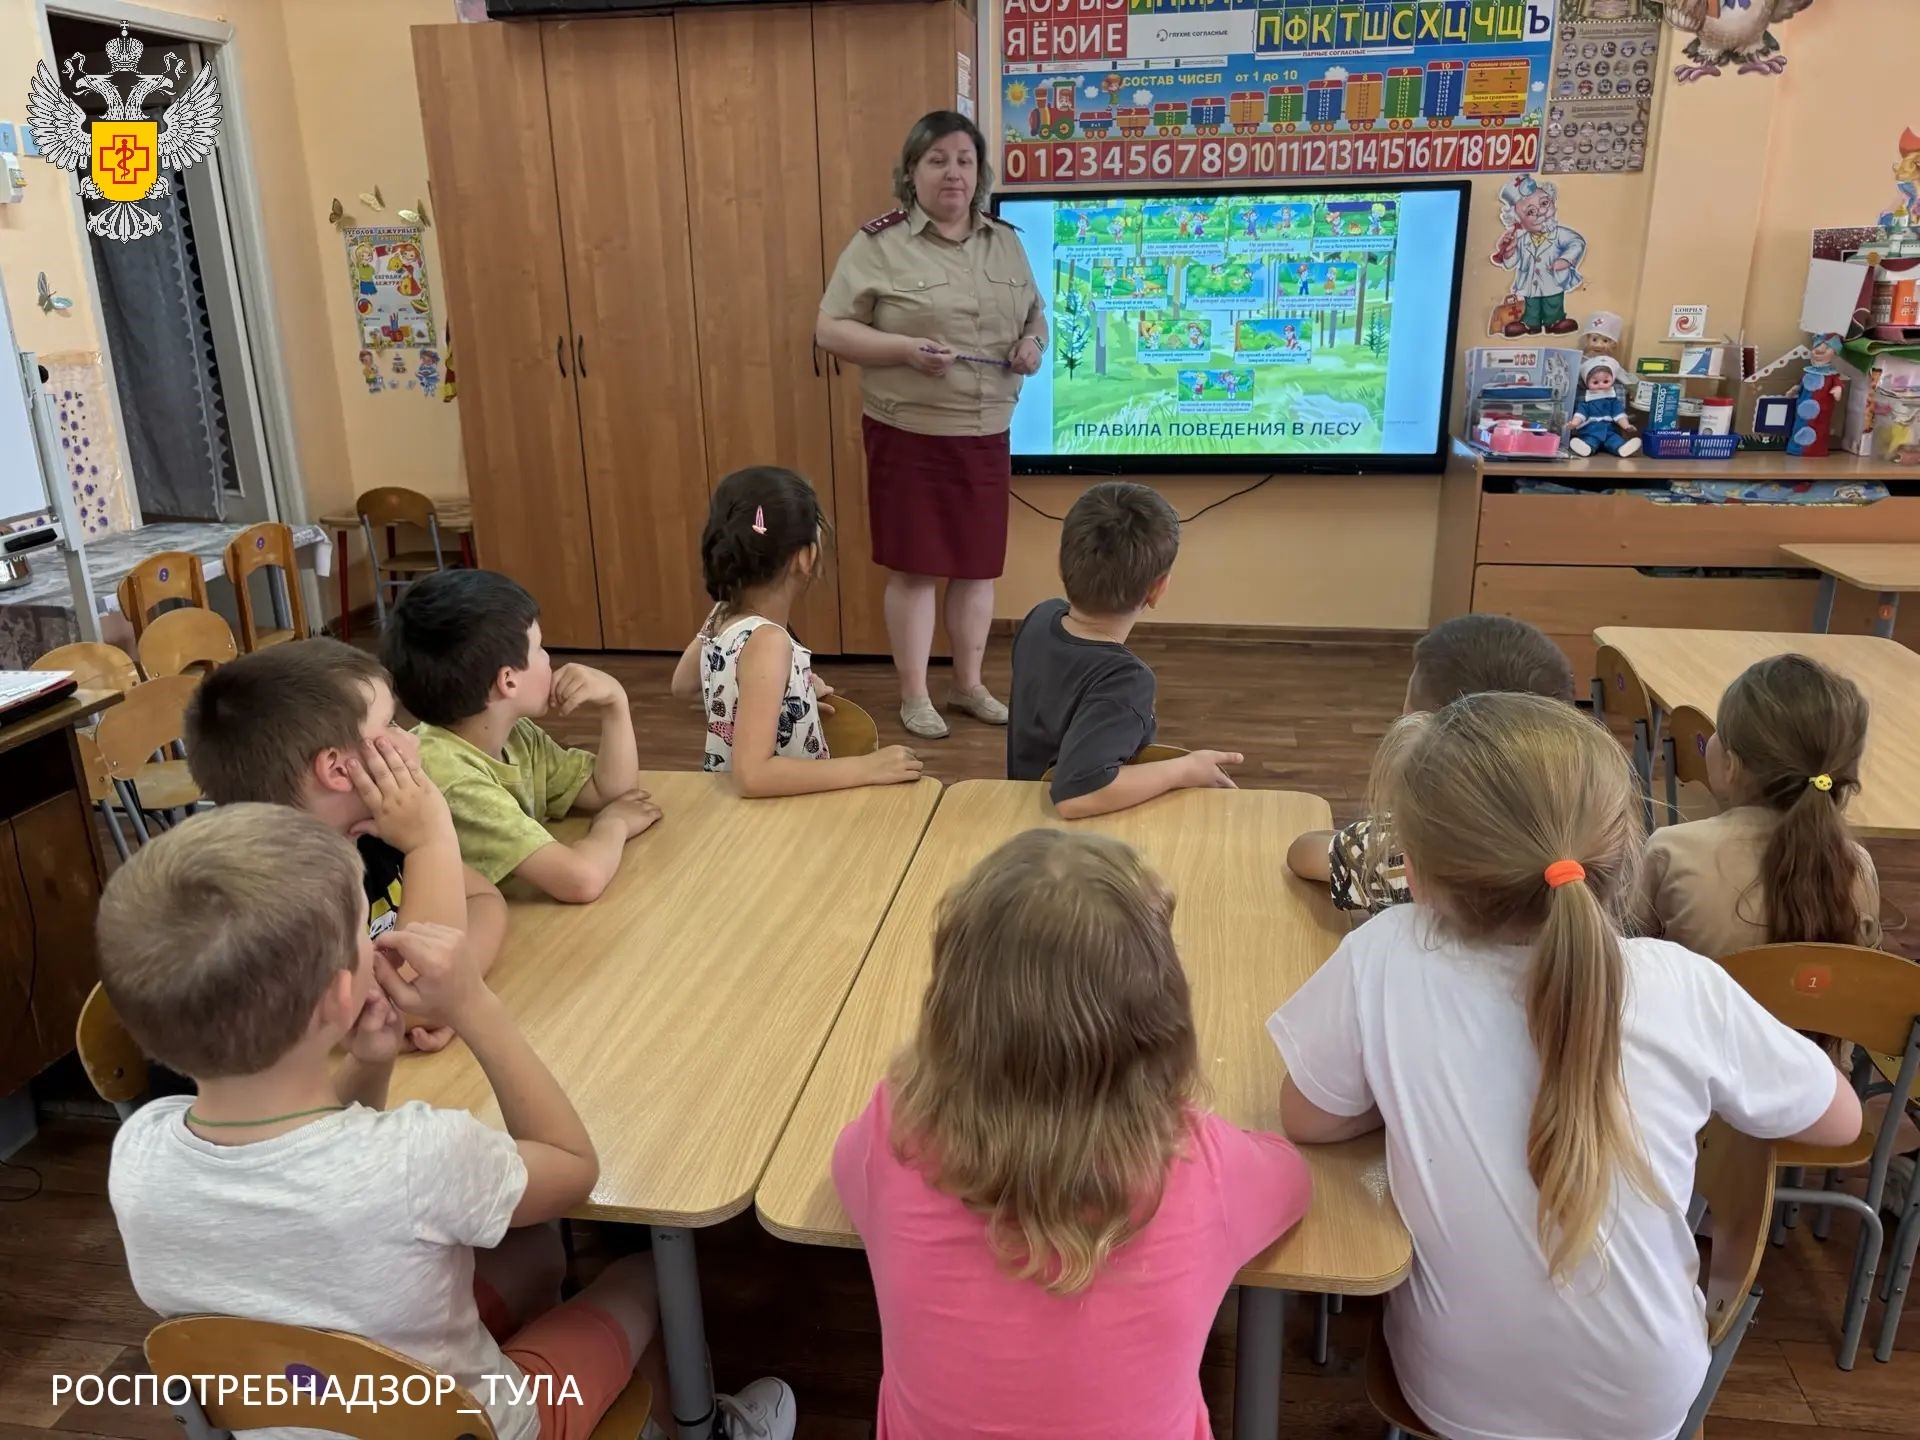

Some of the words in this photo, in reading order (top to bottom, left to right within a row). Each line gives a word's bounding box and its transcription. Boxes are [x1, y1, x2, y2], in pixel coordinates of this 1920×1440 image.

[1122, 74, 1174, 87] СОСТАВ
[1178, 73, 1222, 85] ЧИСЕЛ
[1235, 74, 1249, 82] от
[1253, 72, 1259, 81] 1
[1263, 72, 1278, 82] до
[1283, 70, 1298, 80] 10
[1007, 149, 1026, 178] 0
[1034, 148, 1047, 177] 1
[1055, 148, 1074, 177] 2
[1079, 147, 1098, 176] 3
[1103, 146, 1123, 175] 4
[1127, 145, 1147, 175] 5
[1152, 144, 1172, 174] 6
[1179, 144, 1197, 174] 7
[1201, 143, 1222, 173] 8
[1227, 142, 1248, 172] 9
[1251, 141, 1275, 172] 10
[1277, 141, 1299, 172] 11
[1302, 140, 1326, 171] 12
[1328, 139, 1351, 170] 13
[1354, 138, 1377, 170] 14
[1380, 138, 1404, 169] 15
[1406, 137, 1430, 168] 16
[1433, 135, 1458, 168] 17
[1459, 135, 1483, 167] 18
[1486, 134, 1511, 166] 19
[1510, 133, 1537, 165] 20
[1513, 353, 1536, 367] 103
[1074, 423, 1162, 437] ПРАВИЛА
[1169, 422, 1285, 439] ПОВЕДЕНИЯ
[1292, 422, 1304, 436] В
[1311, 422, 1361, 436] ЛЕСУ
[1808, 976, 1818, 988] 1
